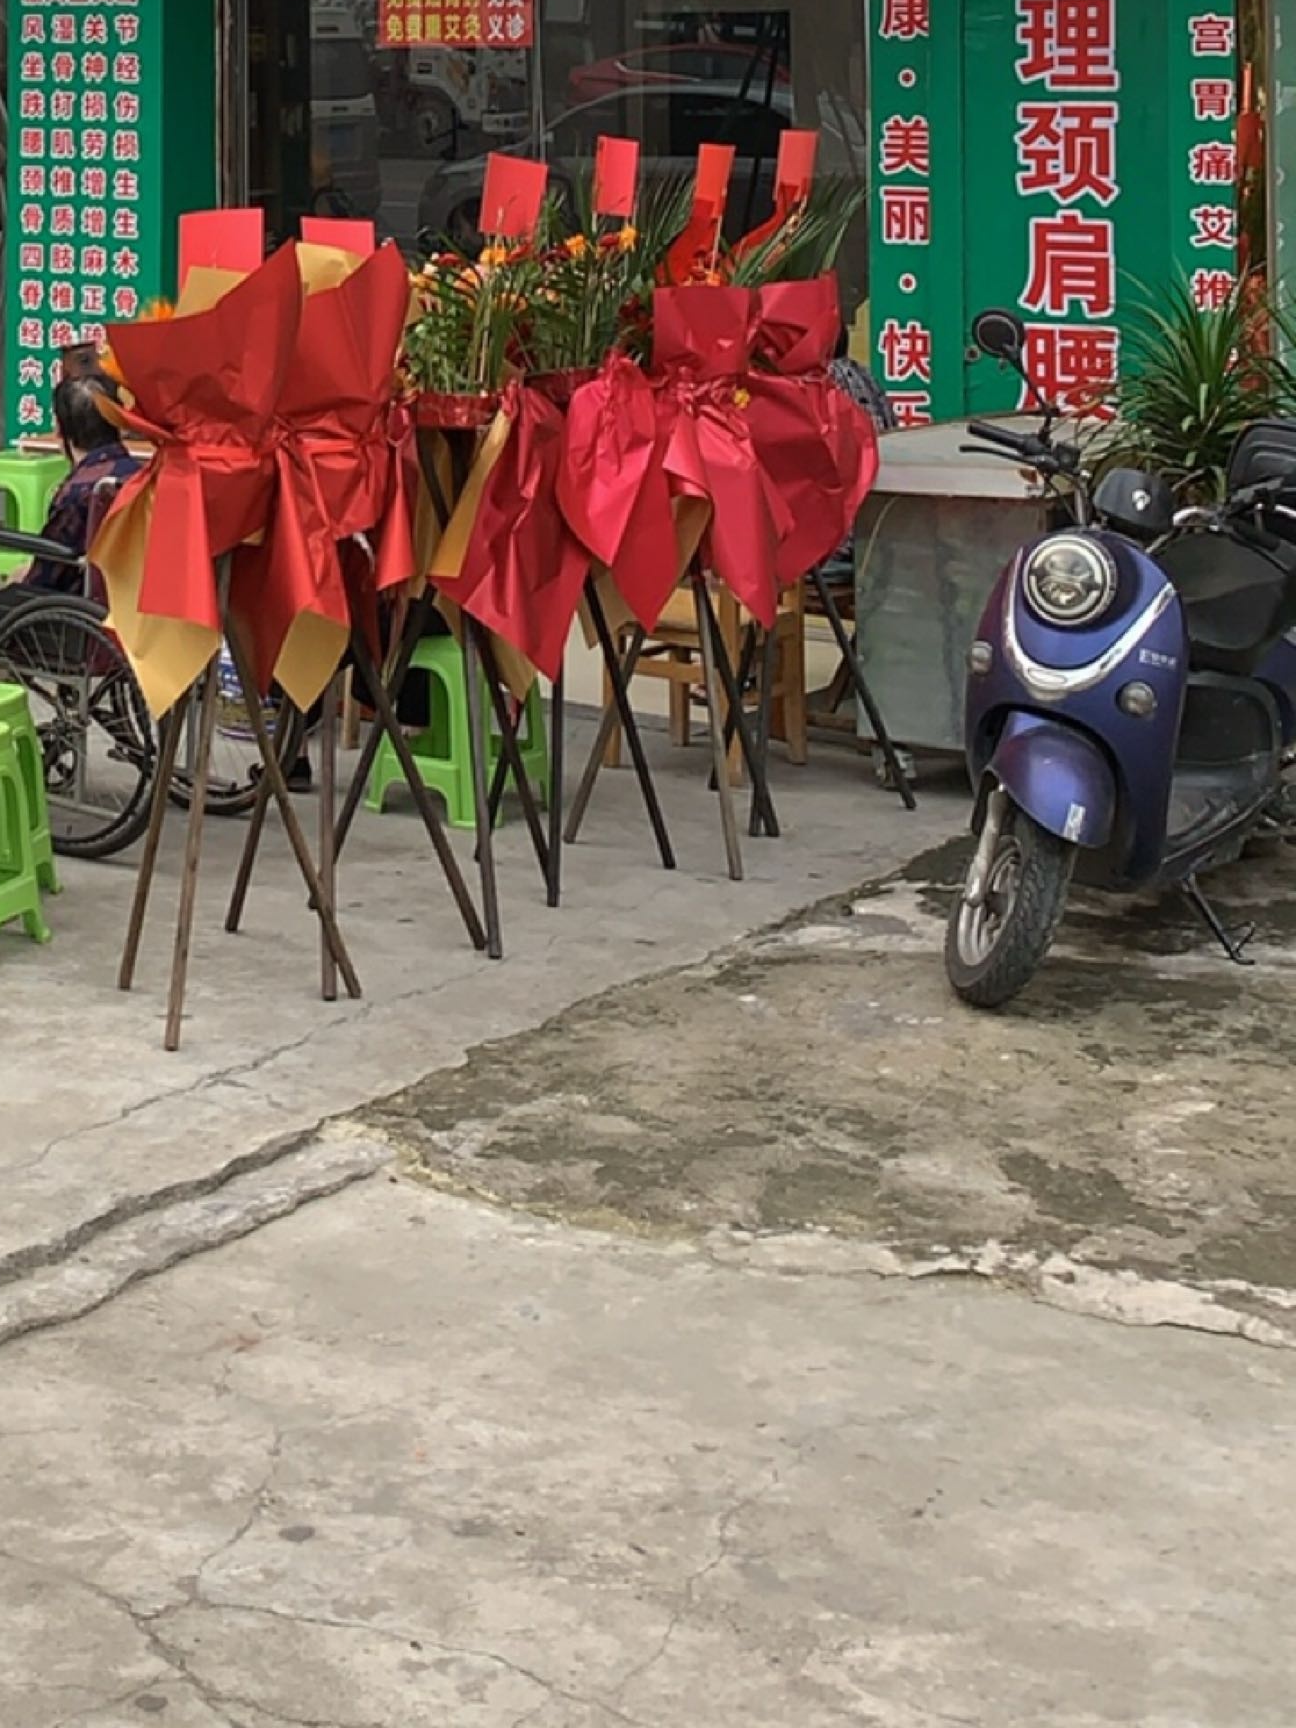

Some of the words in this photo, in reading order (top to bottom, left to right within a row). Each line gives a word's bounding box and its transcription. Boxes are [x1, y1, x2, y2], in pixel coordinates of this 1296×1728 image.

[21, 14, 139, 45] 风湿关节
[488, 10, 526, 40] 义诊
[21, 52, 140, 84] 坐骨神经
[20, 89, 140, 123] 跌打损伤
[20, 127, 140, 161] 腰肌劳损
[20, 165, 140, 200] 颈椎增生
[20, 203, 140, 238] 骨质增生
[19, 242, 140, 278] 四肢麻木
[19, 279, 138, 317] 脊椎正骨
